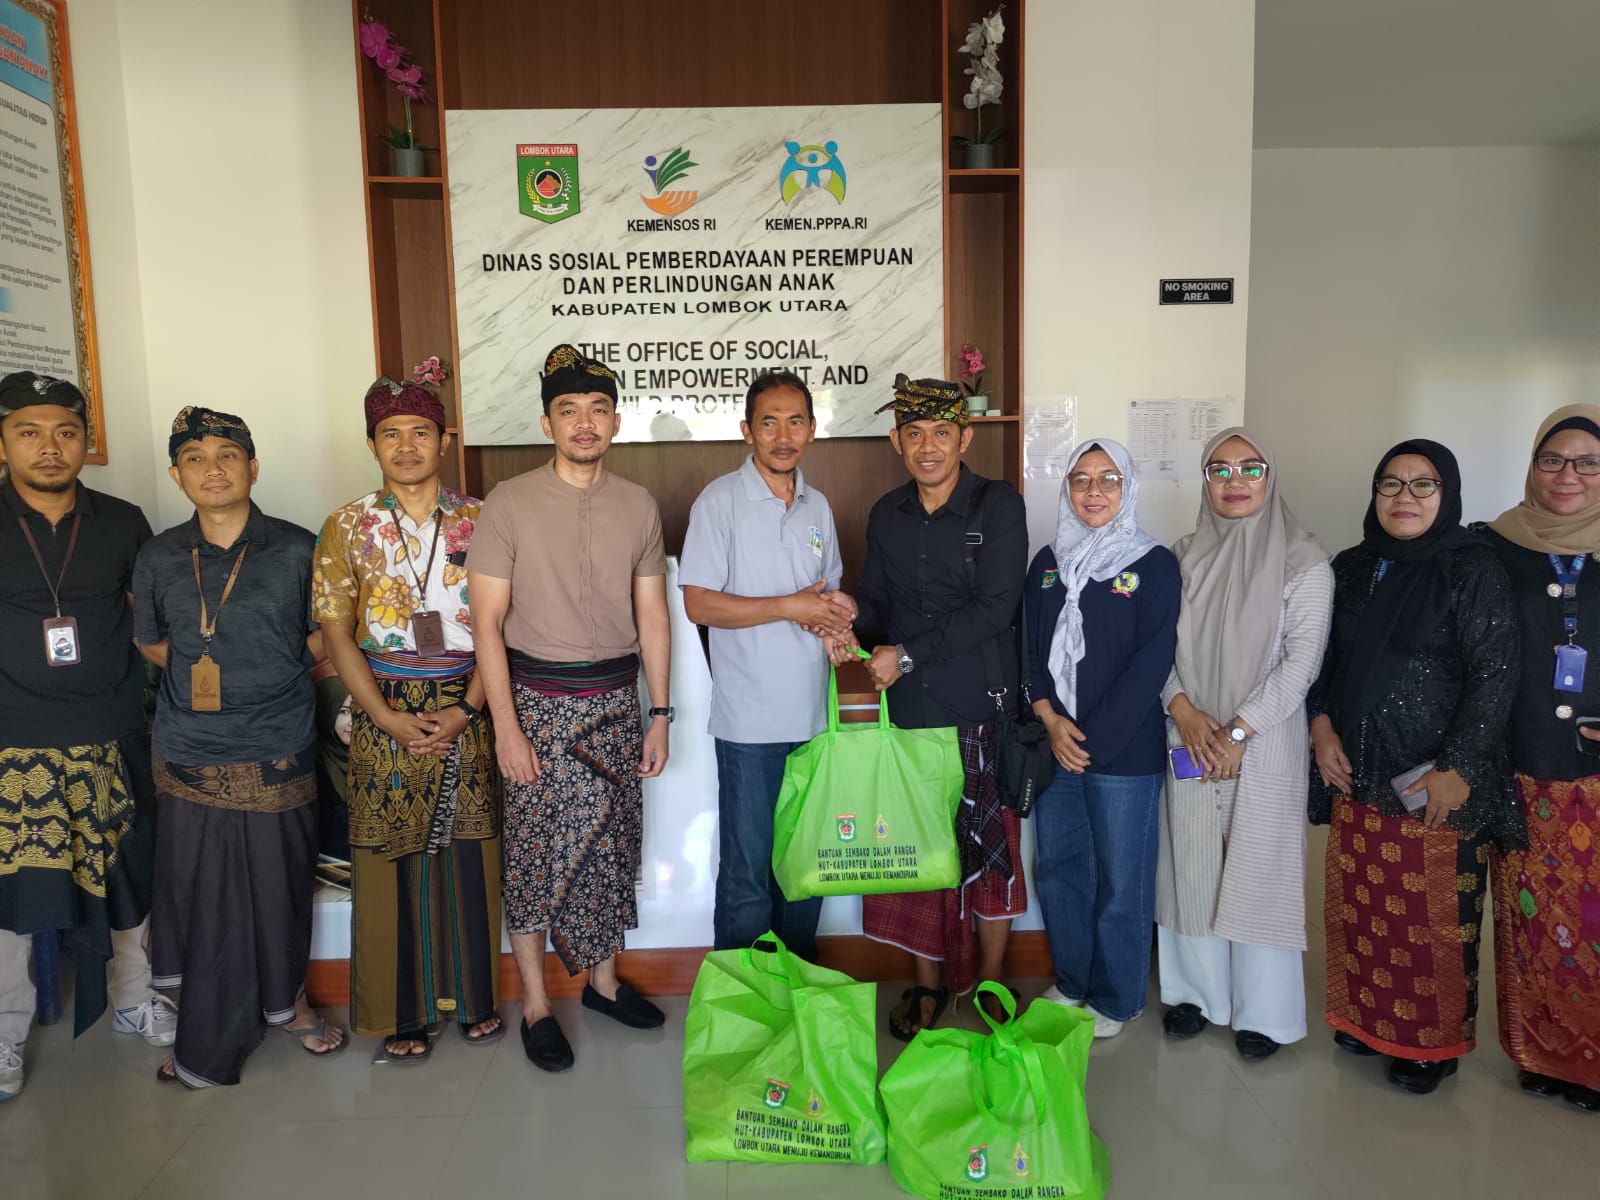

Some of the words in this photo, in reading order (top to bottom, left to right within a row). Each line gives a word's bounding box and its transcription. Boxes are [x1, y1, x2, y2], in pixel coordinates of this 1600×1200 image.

[520, 146, 549, 155] LOMBOK
[550, 146, 574, 155] UTARA
[627, 219, 700, 232] KEMENSOS
[703, 219, 716, 231] RI
[765, 217, 868, 231] KEMEN.PPPA.RI
[482, 253, 543, 272] DINAS
[549, 252, 621, 271] SOSIAL
[627, 250, 786, 270] PEMBERDAYAAN
[793, 248, 913, 267] PEREMPUAN
[563, 276, 605, 295] DAN
[613, 273, 772, 294] PERLINDUNGAN
[778, 273, 835, 291] ANAK
[1164, 282, 1180, 291] NO
[1181, 282, 1229, 291] SMOKING
[1183, 292, 1210, 301] AREA
[552, 303, 676, 316] KABUPATEN
[684, 301, 772, 314] LOMBOK
[780, 300, 848, 312] UTARA
[578, 342, 621, 363] THE
[627, 341, 704, 362] OFFICE
[709, 340, 738, 361] OF
[745, 339, 828, 362] SOCIAL,
[822, 365, 868, 385] AND
[817, 848, 842, 858] BANTUAN
[845, 847, 870, 857] SEMBAKO
[873, 846, 891, 856] DALAM
[894, 845, 916, 854] RANGKA
[818, 859, 867, 870] HUT-KABUPATEN
[870, 859, 894, 868] LOMBOK
[897, 858, 917, 867] UTARA
[819, 872, 840, 882] LOMBOK
[841, 871, 859, 880] UTARA
[860, 871, 882, 880] MENUJU
[883, 870, 918, 879] KEMANDIRIAN
[736, 1109, 765, 1123] BANTUAN
[769, 1115, 798, 1129] SEMBAKO
[801, 1121, 823, 1134] DALAM
[827, 1122, 850, 1135] RANGKA
[735, 1123, 792, 1141] HUT-KABUPATEN
[797, 1133, 825, 1147] LOMBOK
[829, 1137, 851, 1148] UTARA
[734, 1138, 758, 1151] LOMBOK
[760, 1142, 780, 1153] UTARA
[782, 1145, 807, 1156] MENUJU
[810, 1149, 851, 1160] KEMANDIRIAN
[975, 1189, 1007, 1198] SEMBAKO
[1011, 1186, 1033, 1199] DALAM
[1037, 1185, 1065, 1198] RANGKA
